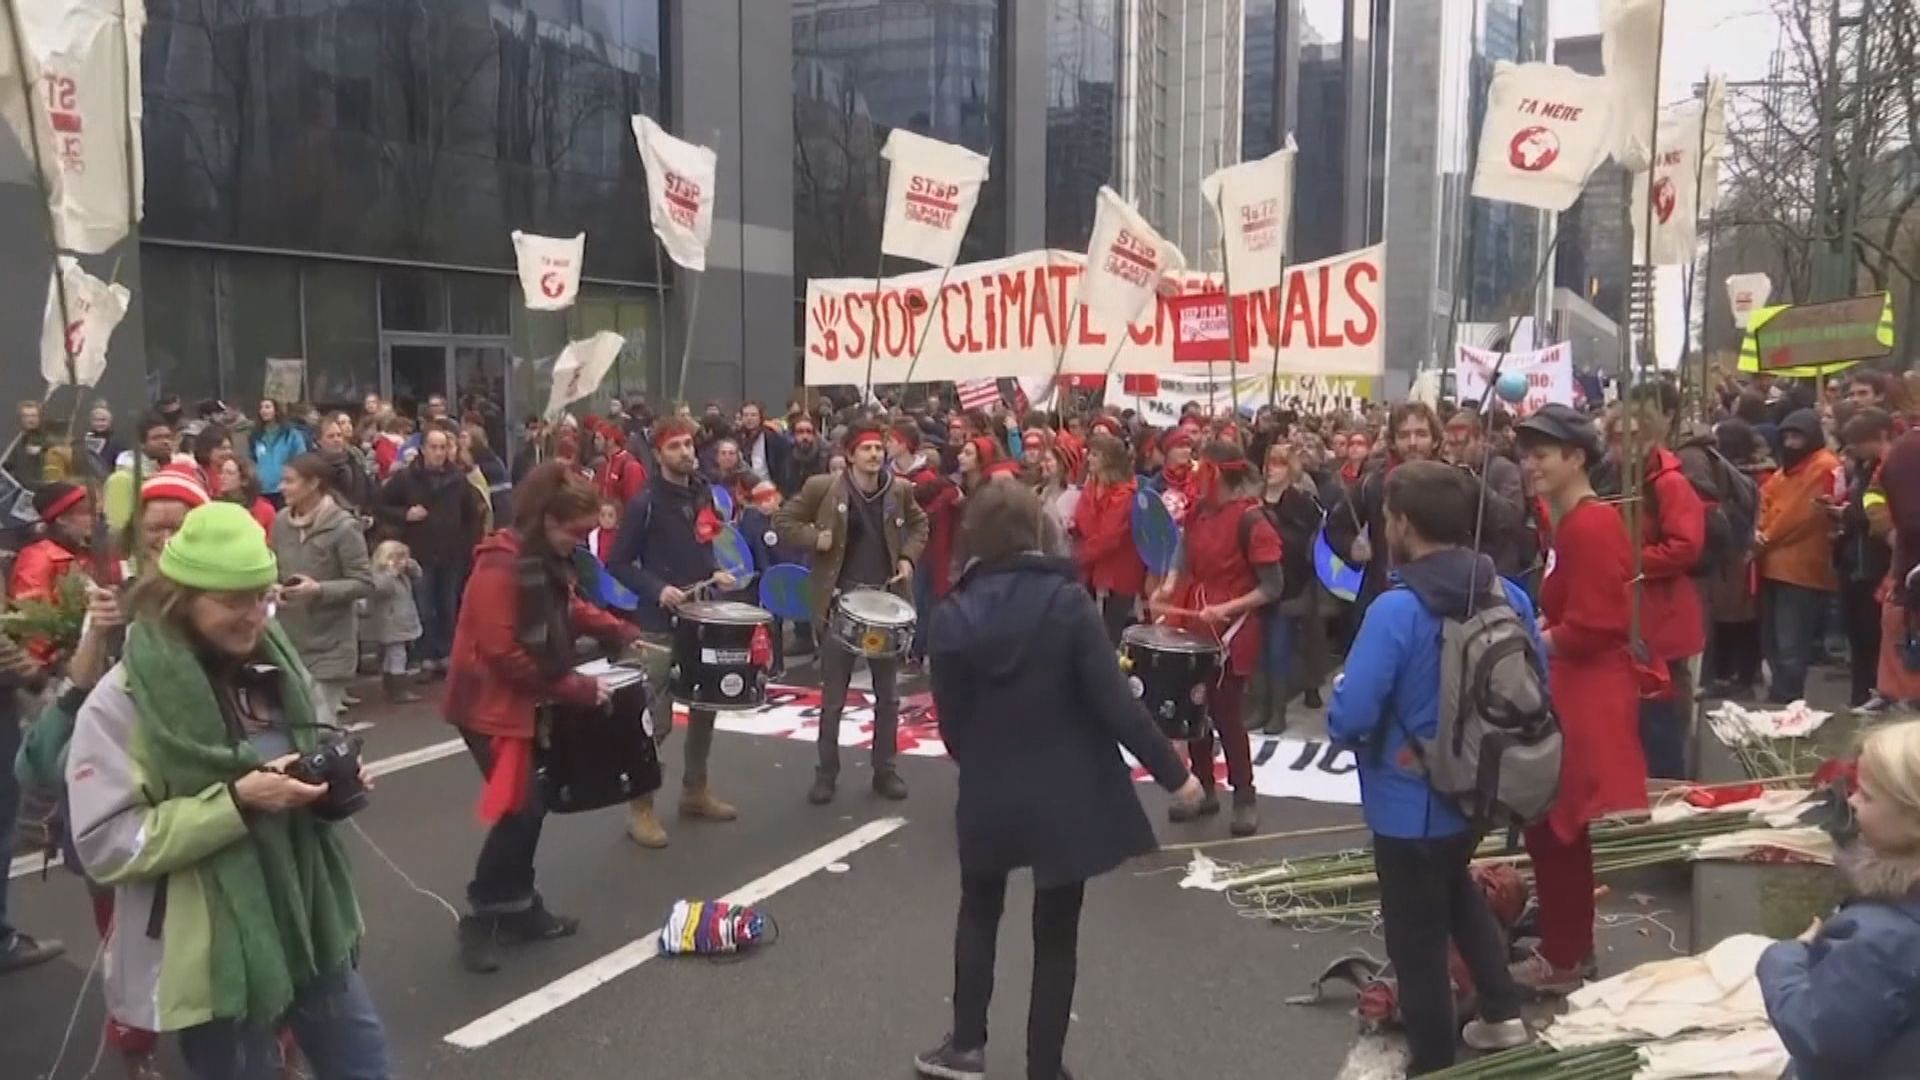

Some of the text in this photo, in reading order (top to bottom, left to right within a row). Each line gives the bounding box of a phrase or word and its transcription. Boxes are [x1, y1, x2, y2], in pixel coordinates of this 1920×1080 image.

[1518, 98, 1538, 114] TA
[844, 288, 928, 360] STOP
[1148, 401, 1174, 415] PAS
